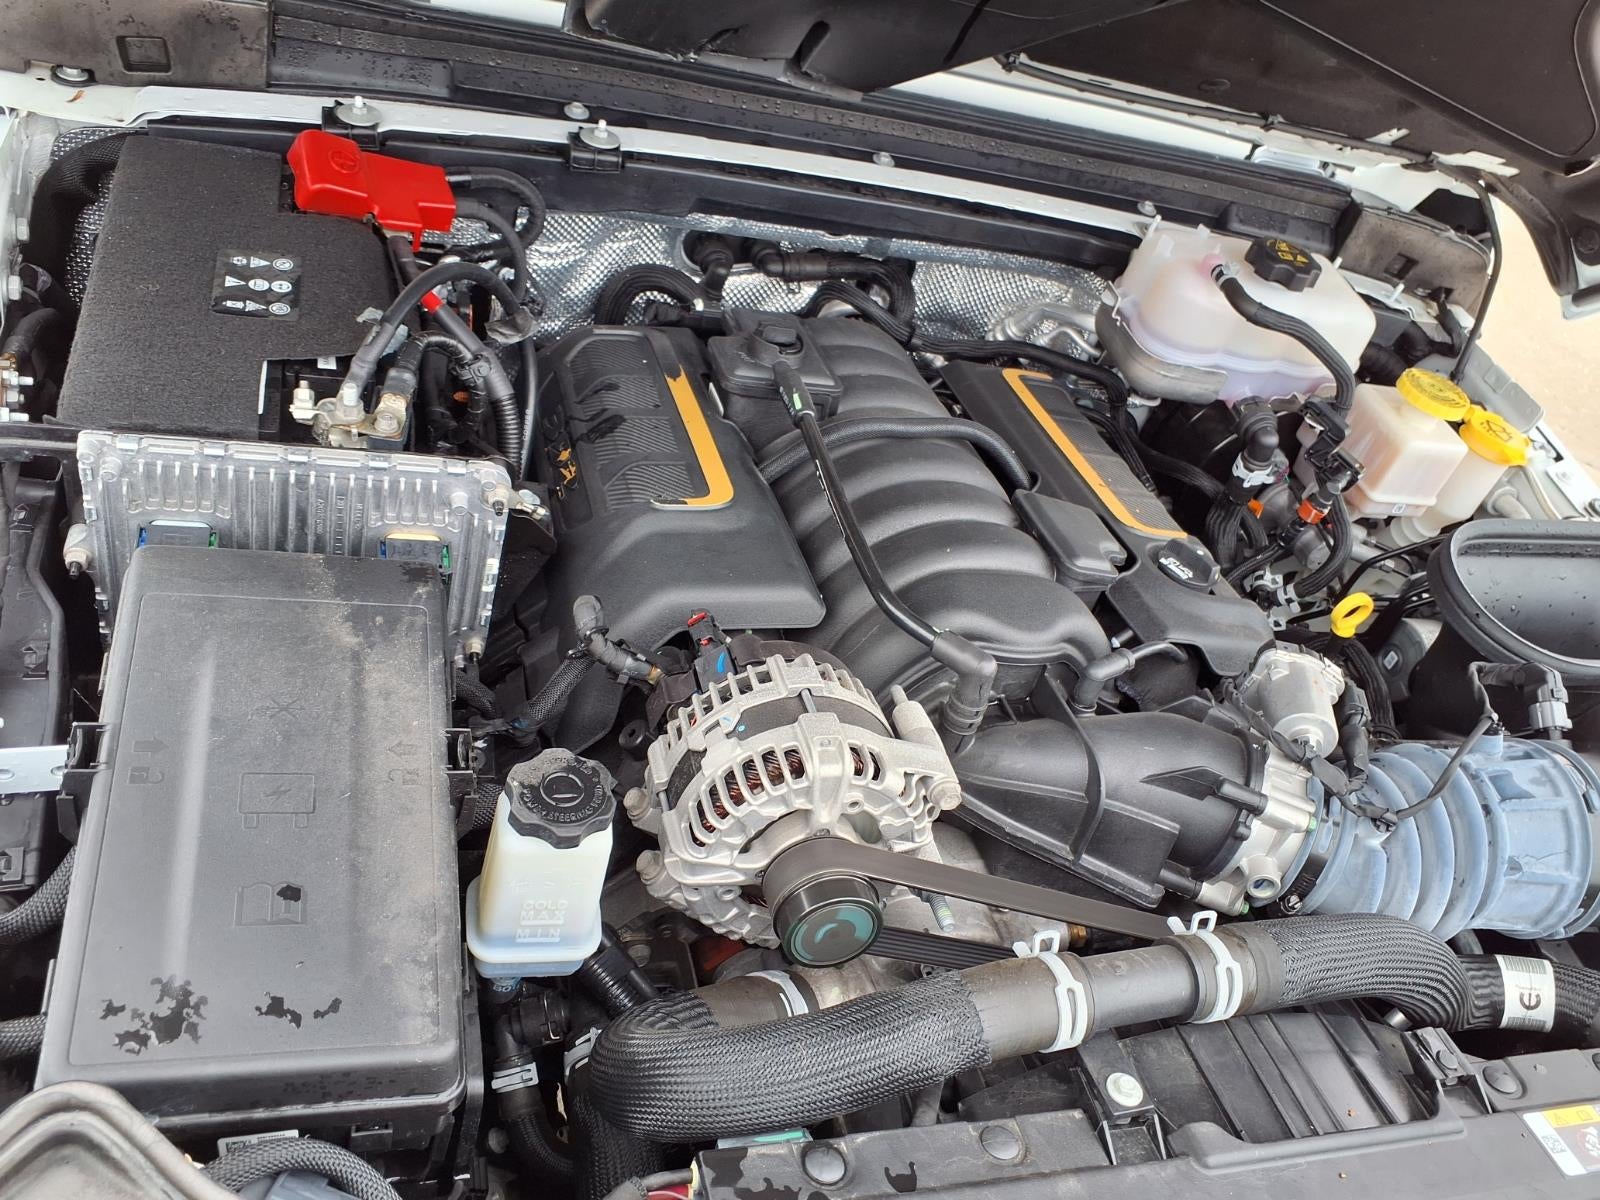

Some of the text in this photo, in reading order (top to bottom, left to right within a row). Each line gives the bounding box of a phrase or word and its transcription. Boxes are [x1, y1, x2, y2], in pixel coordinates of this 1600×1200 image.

[522, 786, 548, 817] POWER
[548, 806, 594, 822] STEERING
[522, 900, 569, 911] COLD
[520, 911, 566, 921] MAX
[515, 928, 561, 939] MIN
